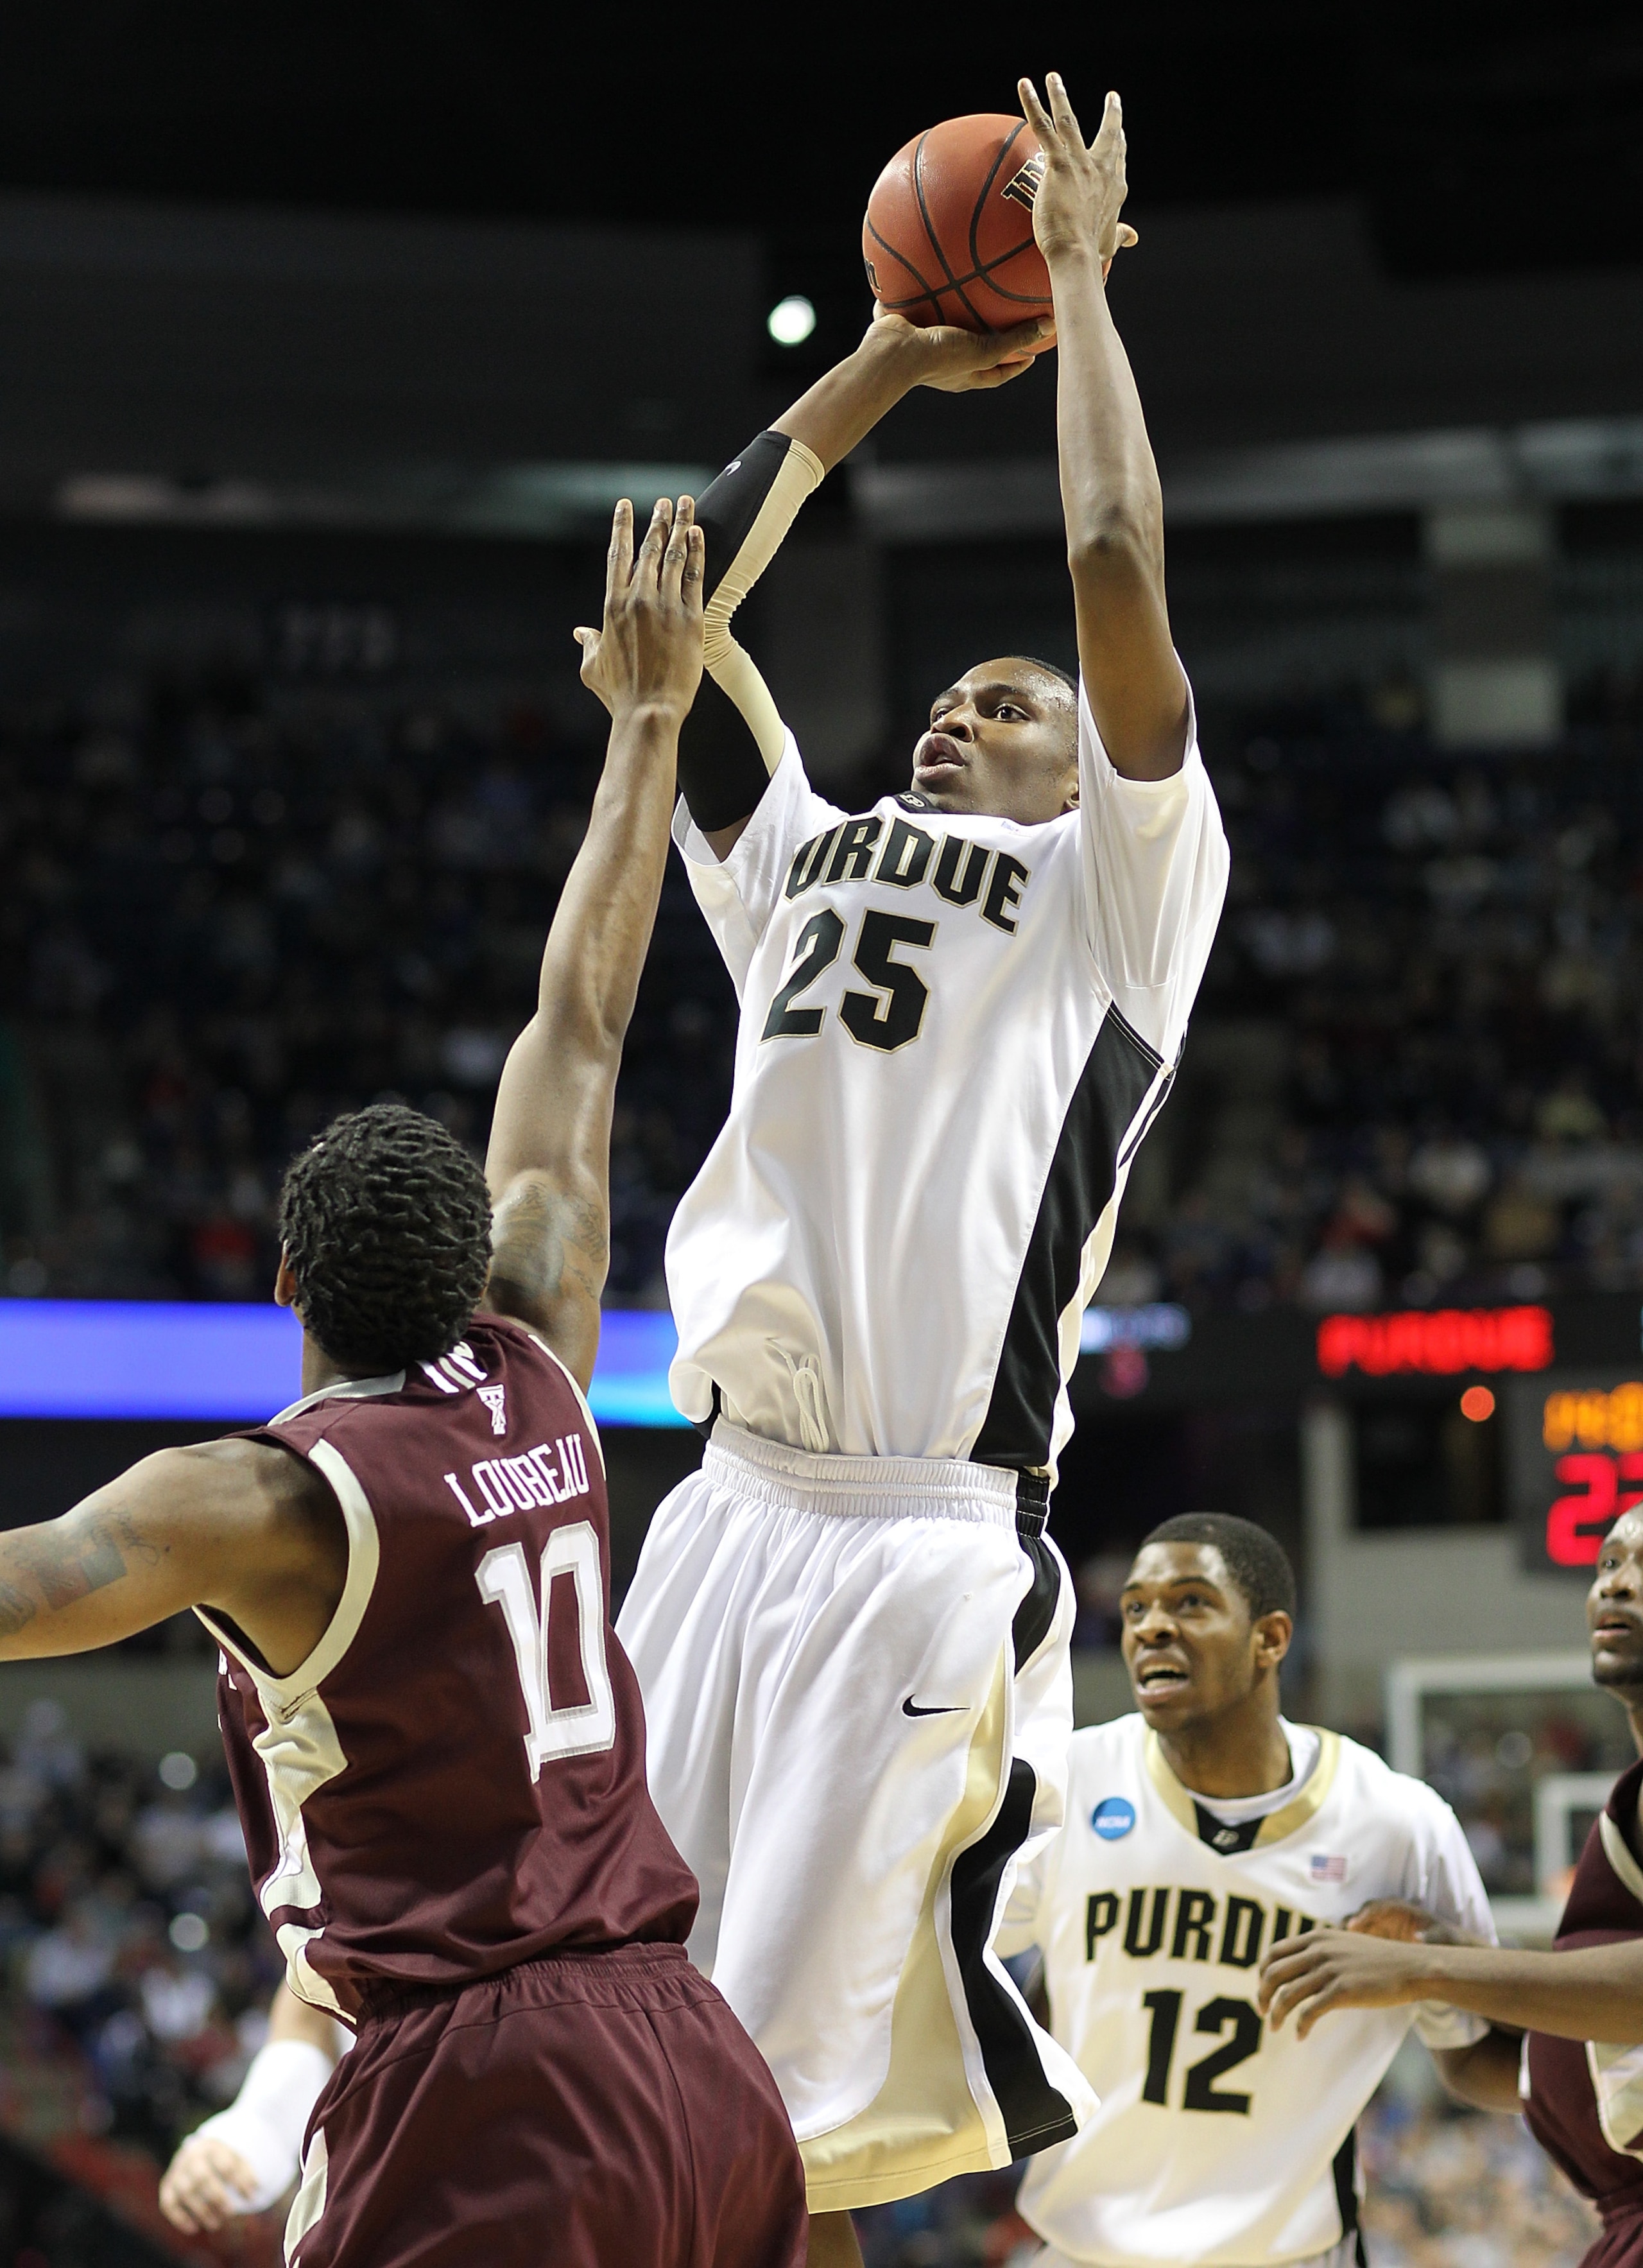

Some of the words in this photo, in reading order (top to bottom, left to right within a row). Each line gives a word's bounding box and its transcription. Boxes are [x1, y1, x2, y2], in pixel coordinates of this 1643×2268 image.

[785, 815, 1030, 935] URDUE
[759, 908, 938, 1053] 25
[444, 1433, 589, 1527] LOUBEAU
[474, 1519, 616, 1785] 10
[1087, 1888, 1333, 1968] PURD
[1143, 1991, 1262, 2115] 12
